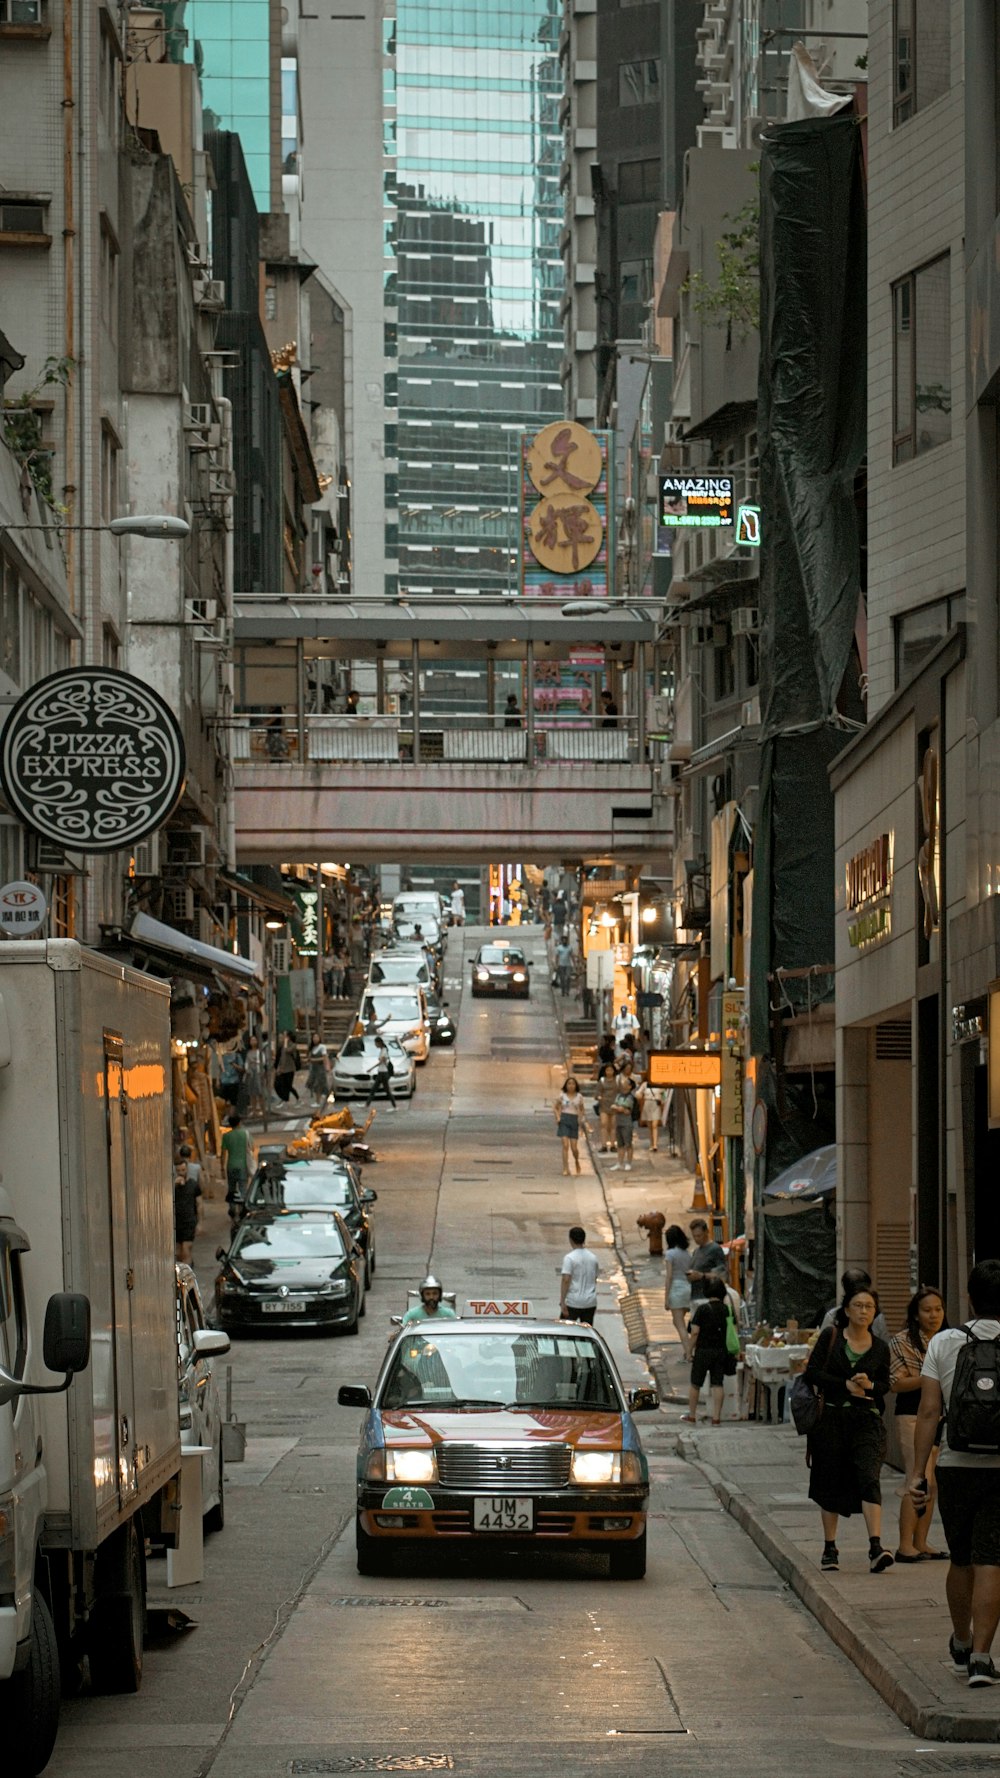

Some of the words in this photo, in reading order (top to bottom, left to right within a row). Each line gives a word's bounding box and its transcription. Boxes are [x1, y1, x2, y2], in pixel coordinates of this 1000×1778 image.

[663, 479, 731, 490] AMAZING
[716, 490, 731, 498] Spa
[48, 734, 136, 755] PIZZA
[23, 756, 161, 777] EXPRESS
[265, 1303, 277, 1311] RY
[281, 1303, 302, 1311] 7155
[470, 1302, 528, 1315] TAXI
[403, 1491, 413, 1501] 4
[492, 1499, 516, 1514] UM
[480, 1514, 529, 1529] 4432
